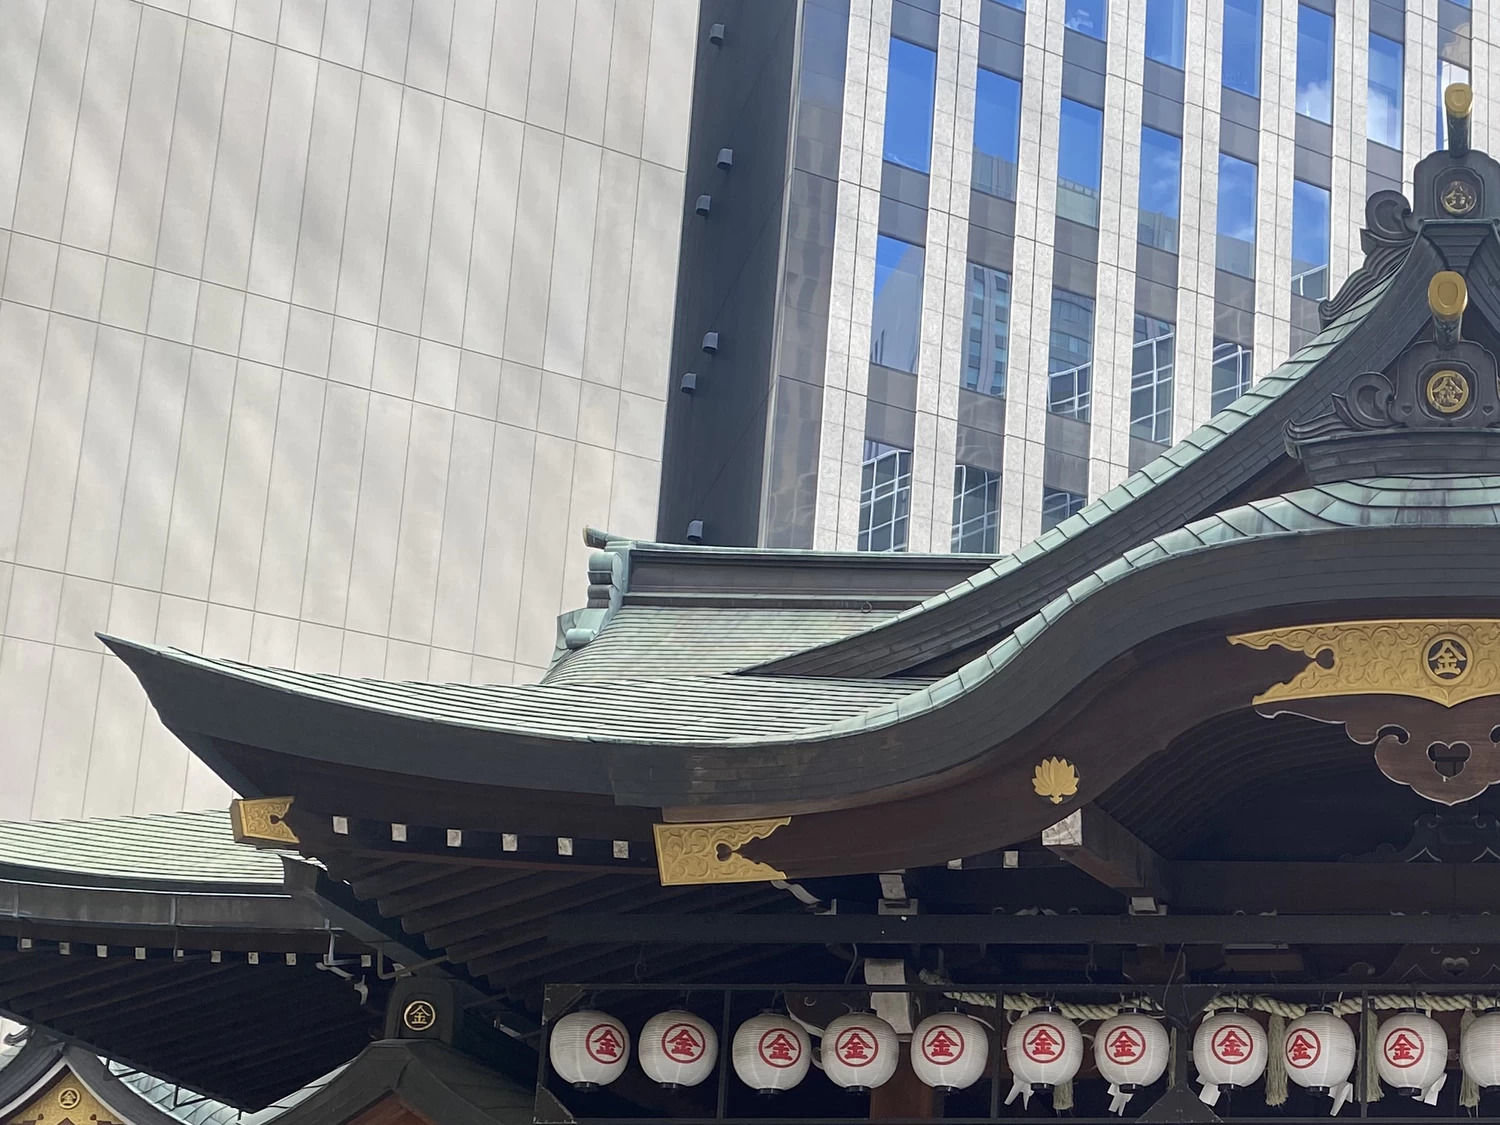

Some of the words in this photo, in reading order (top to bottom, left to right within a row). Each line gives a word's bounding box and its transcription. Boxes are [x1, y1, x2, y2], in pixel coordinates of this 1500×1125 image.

[1429, 641, 1467, 675] 金
[410, 1005, 430, 1024] 金
[592, 1030, 622, 1057] 金
[667, 1029, 700, 1056] 金
[763, 1033, 796, 1061] 金
[840, 1033, 873, 1060] 金
[926, 1031, 959, 1057] 金
[1028, 1029, 1061, 1056] 金
[1108, 1031, 1140, 1057] 金
[1216, 1030, 1249, 1057] 金
[1289, 1034, 1317, 1061] 金
[1388, 1034, 1420, 1061] 金
